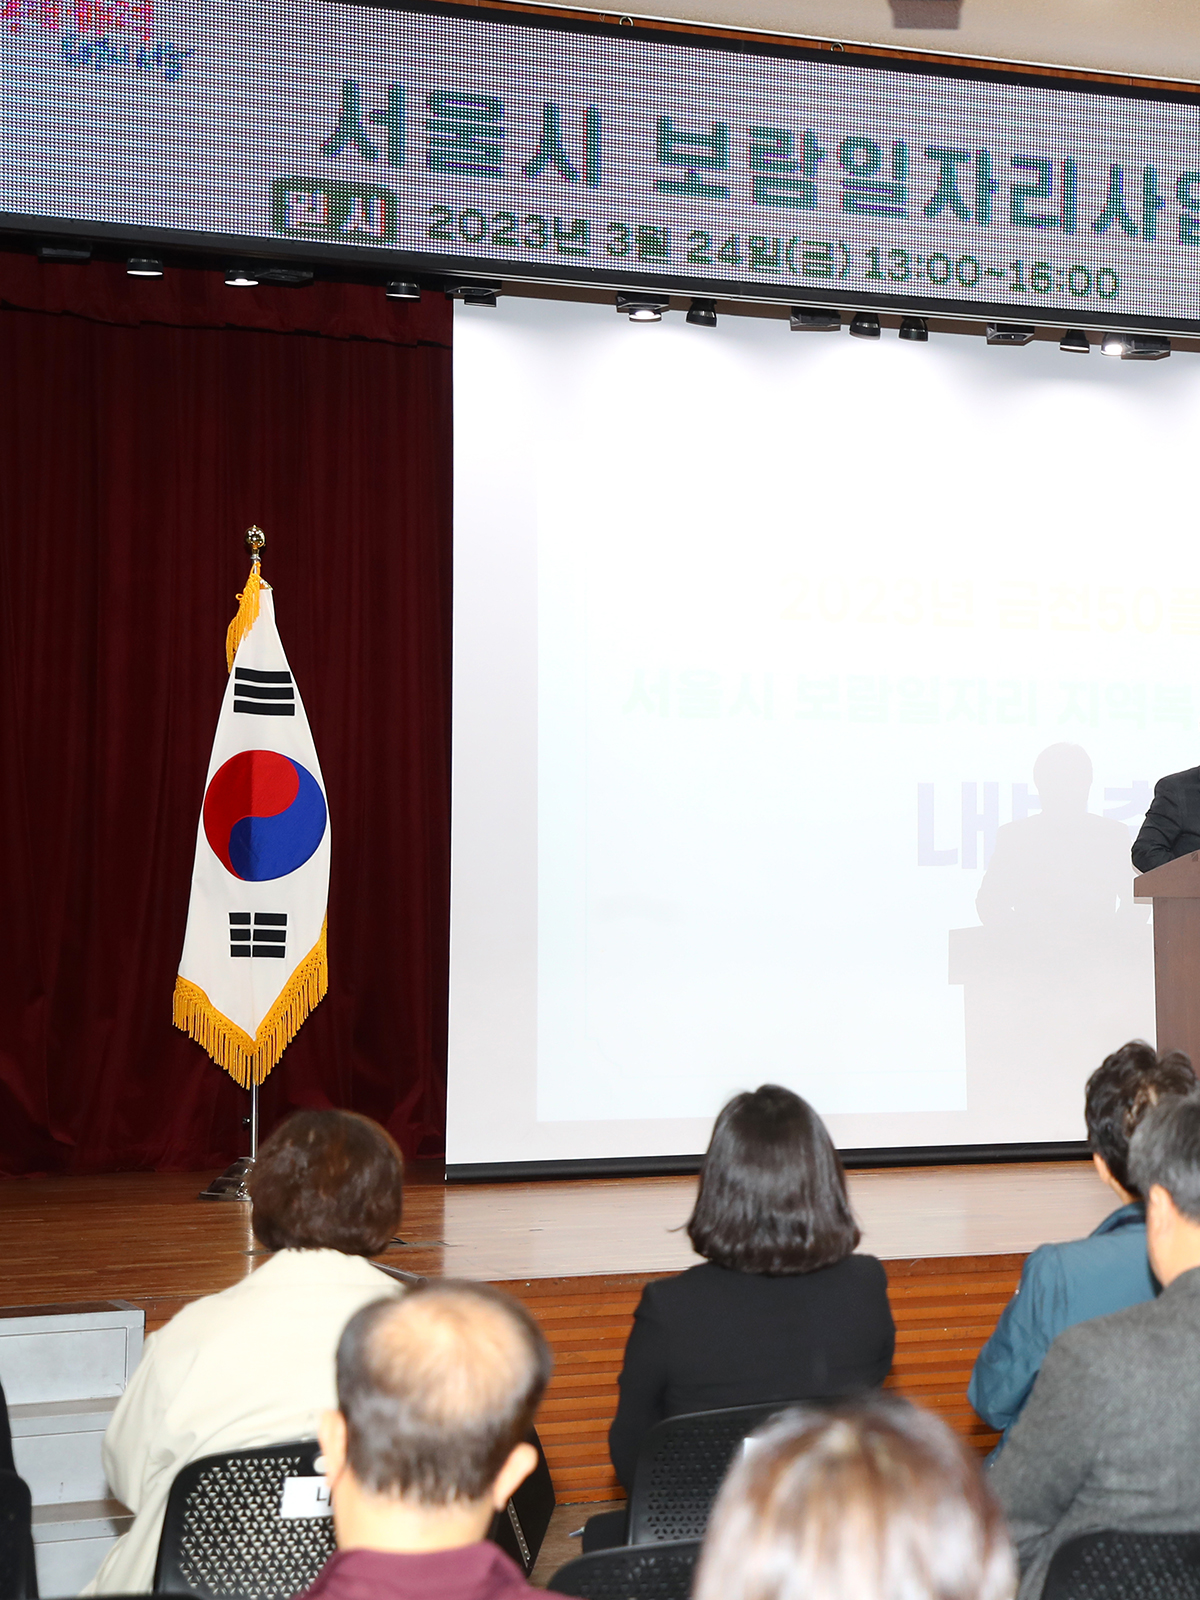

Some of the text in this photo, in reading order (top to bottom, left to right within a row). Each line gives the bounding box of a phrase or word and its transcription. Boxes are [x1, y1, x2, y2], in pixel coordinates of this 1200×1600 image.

[320, 79, 601, 189] 서울시
[428, 205, 1120, 300] 2023년 3월 24일(금) 13:00~16:00
[622, 667, 774, 721] 서울시
[795, 672, 1039, 727] 보람일자리
